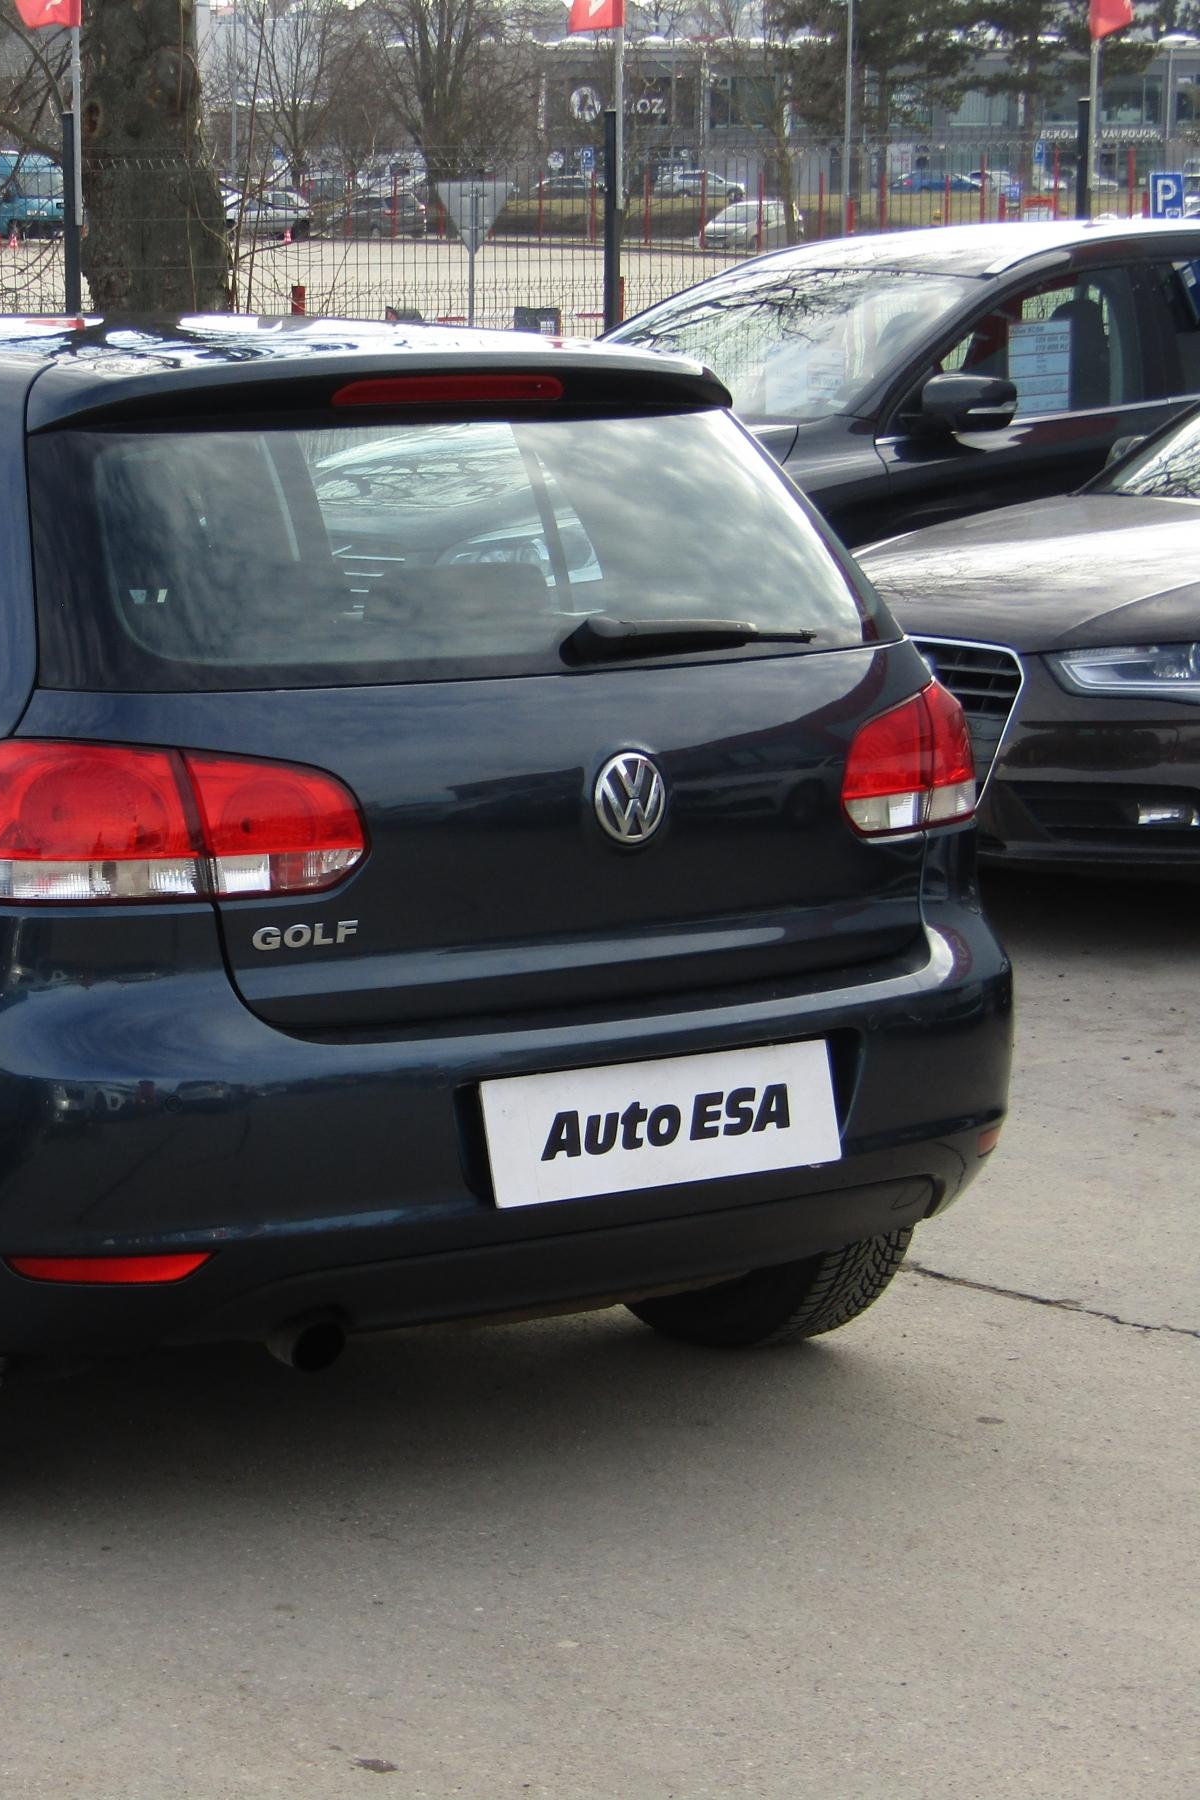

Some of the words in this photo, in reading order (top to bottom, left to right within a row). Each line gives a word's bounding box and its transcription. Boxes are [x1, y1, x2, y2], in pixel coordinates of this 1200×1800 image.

[1157, 179, 1176, 213] P
[252, 919, 359, 951] GOLF
[540, 1101, 682, 1162] Auto
[689, 1083, 791, 1141] ESA
